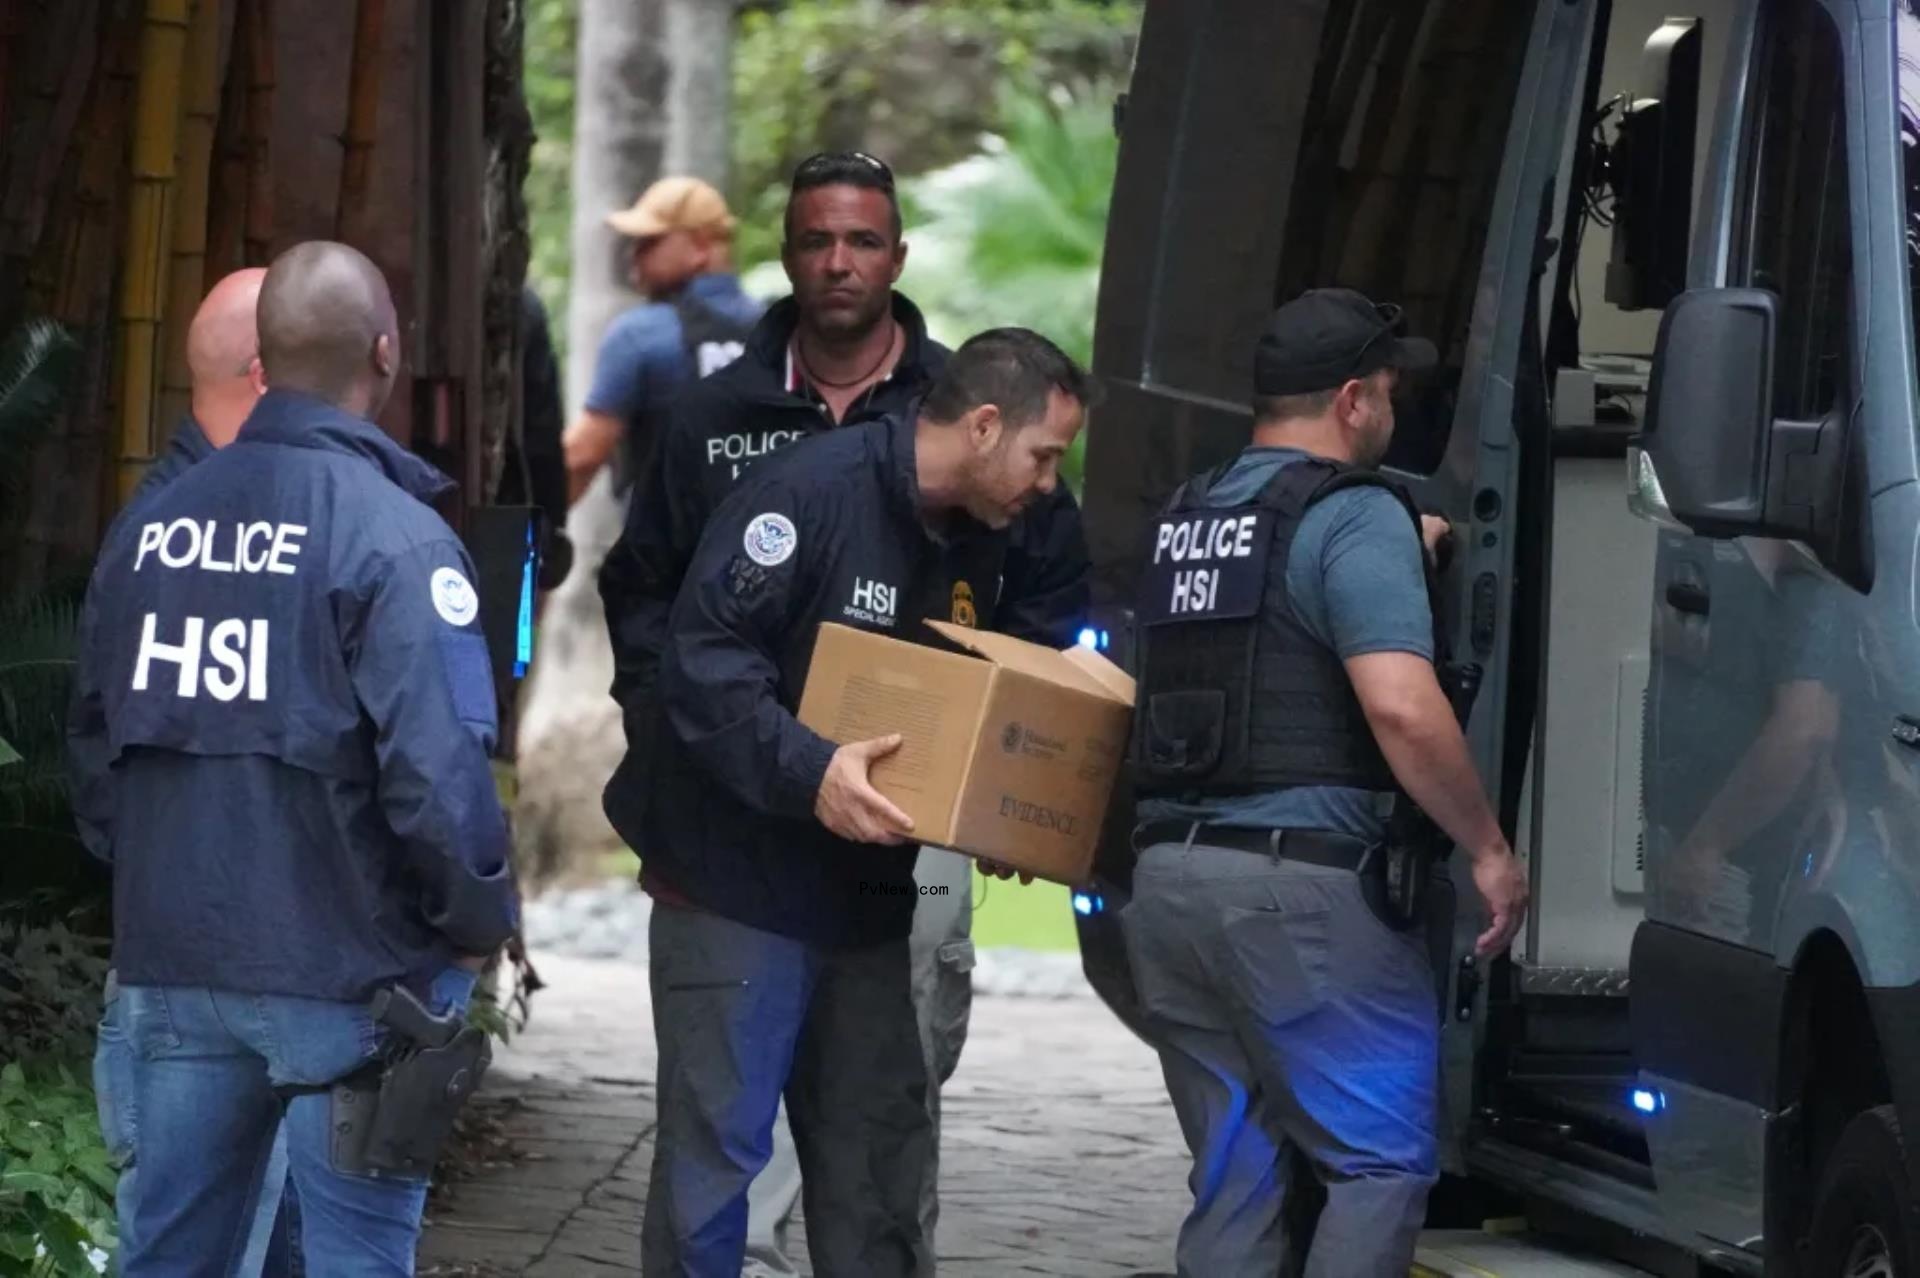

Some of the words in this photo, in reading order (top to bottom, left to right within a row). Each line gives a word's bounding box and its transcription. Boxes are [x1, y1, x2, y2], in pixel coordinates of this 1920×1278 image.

[134, 517, 308, 575] POLICE
[1154, 515, 1257, 564] POLICE
[852, 575, 897, 616] HSI
[1170, 568, 1219, 613] HSI
[132, 612, 269, 701] HSI
[999, 793, 1077, 836] EVIDENCE
